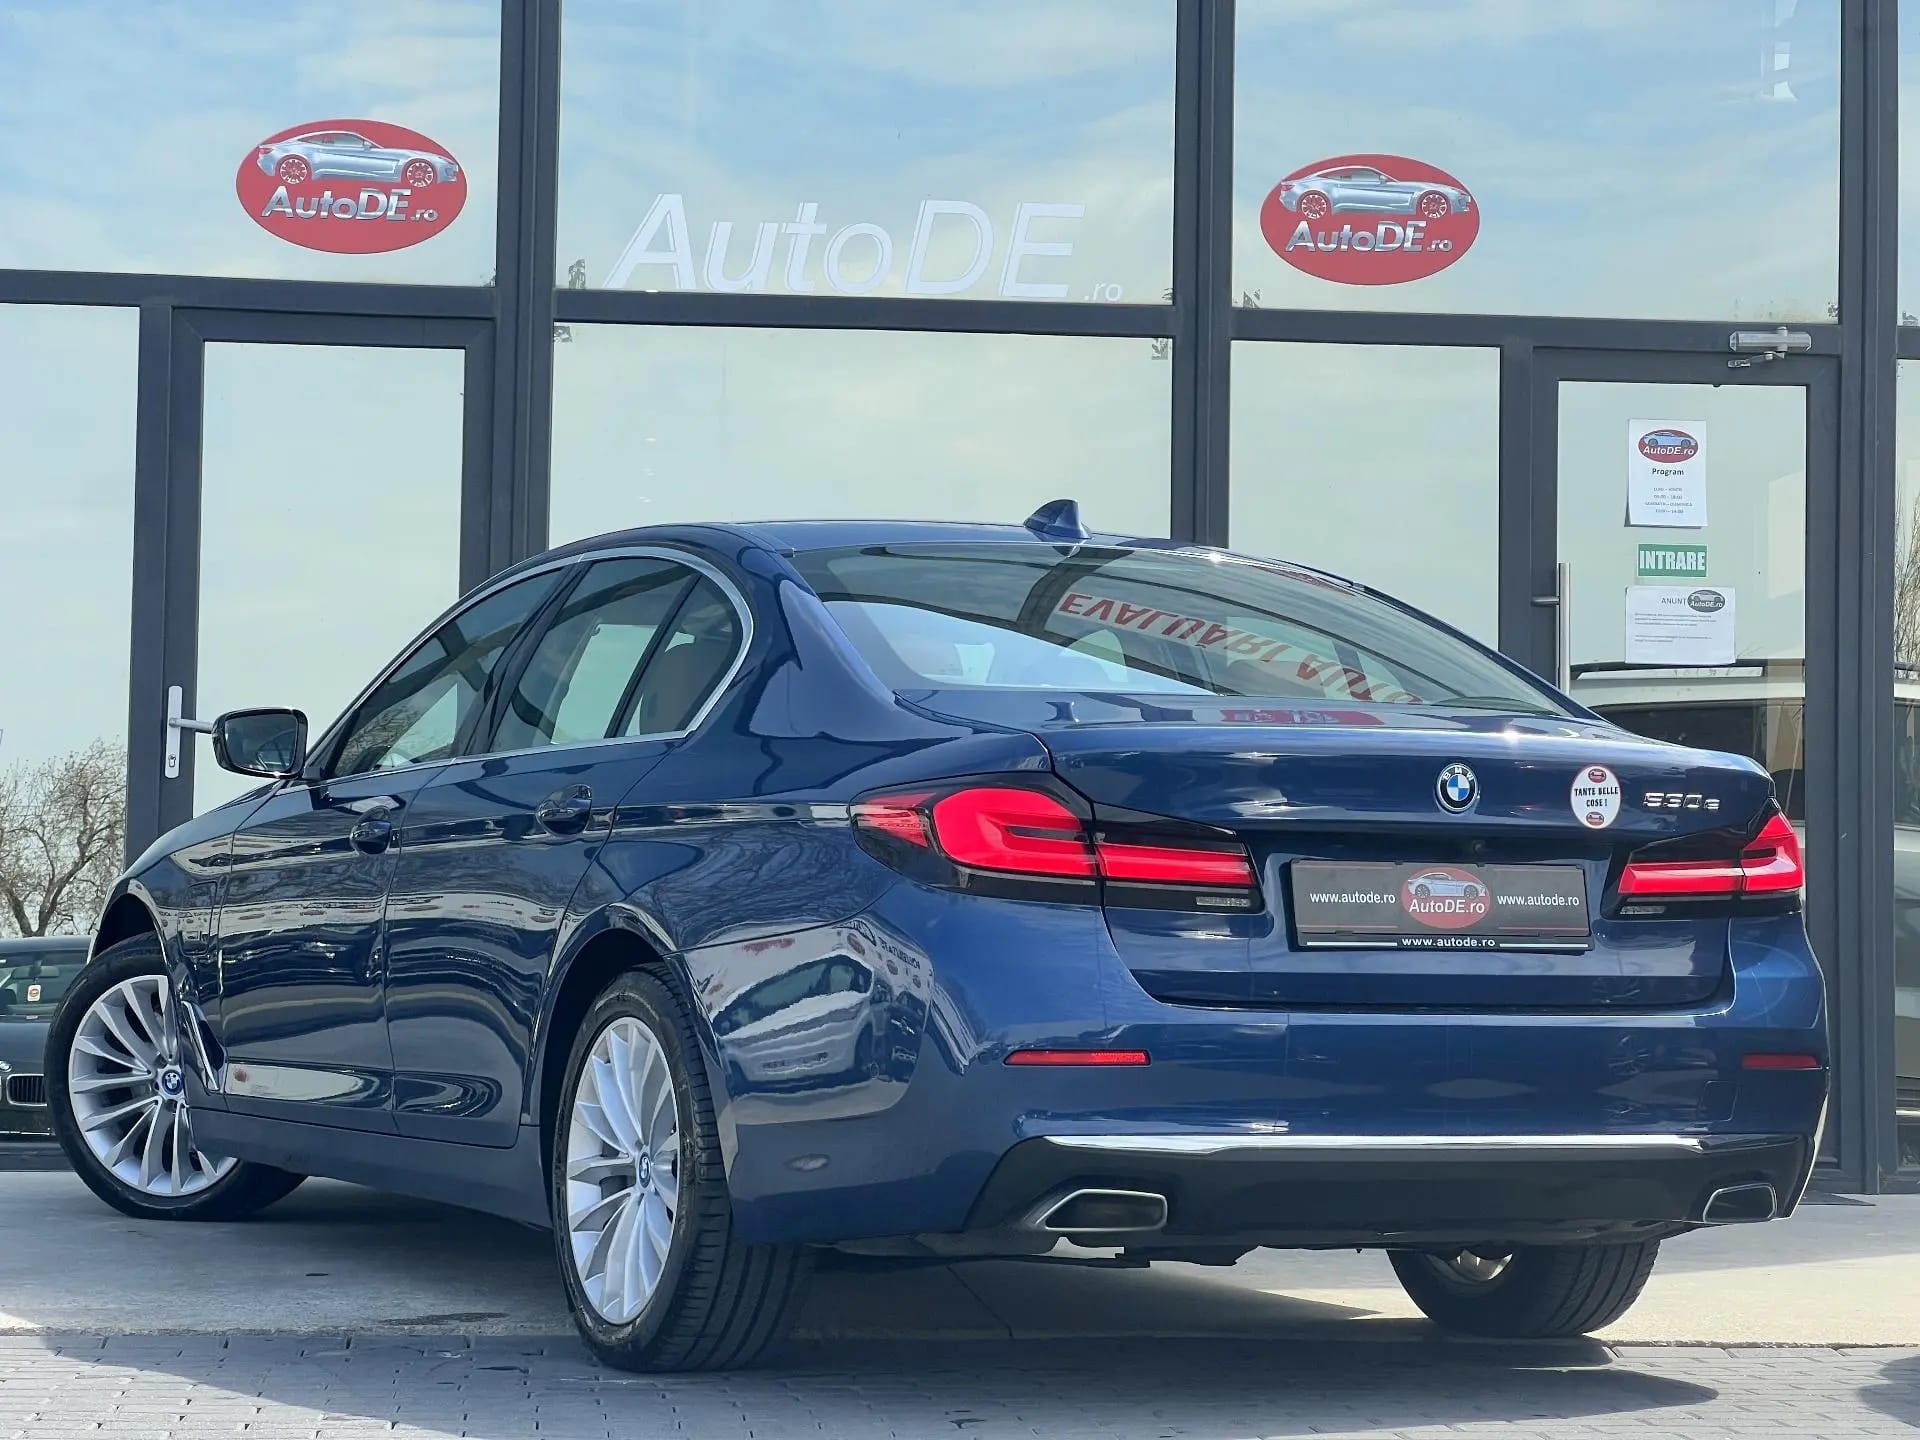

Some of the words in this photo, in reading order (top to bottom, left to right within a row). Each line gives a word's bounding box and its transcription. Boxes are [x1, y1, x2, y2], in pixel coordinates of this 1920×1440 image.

[1643, 446, 1694, 455] AutoDE.ro
[1652, 468, 1684, 476] Program
[1640, 551, 1705, 570] INTRARE
[1443, 766, 1474, 780] BMW
[1574, 788, 1596, 797] TANTE
[1598, 787, 1618, 795] BELLE
[1586, 799, 1603, 807] COSE
[1643, 792, 1721, 810] 530e
[1310, 891, 1396, 904] www.autode.ro
[1497, 893, 1580, 906] www.autode.ro
[1409, 899, 1485, 914] AutoDE.ro
[1402, 937, 1496, 947] www.autode.ro
